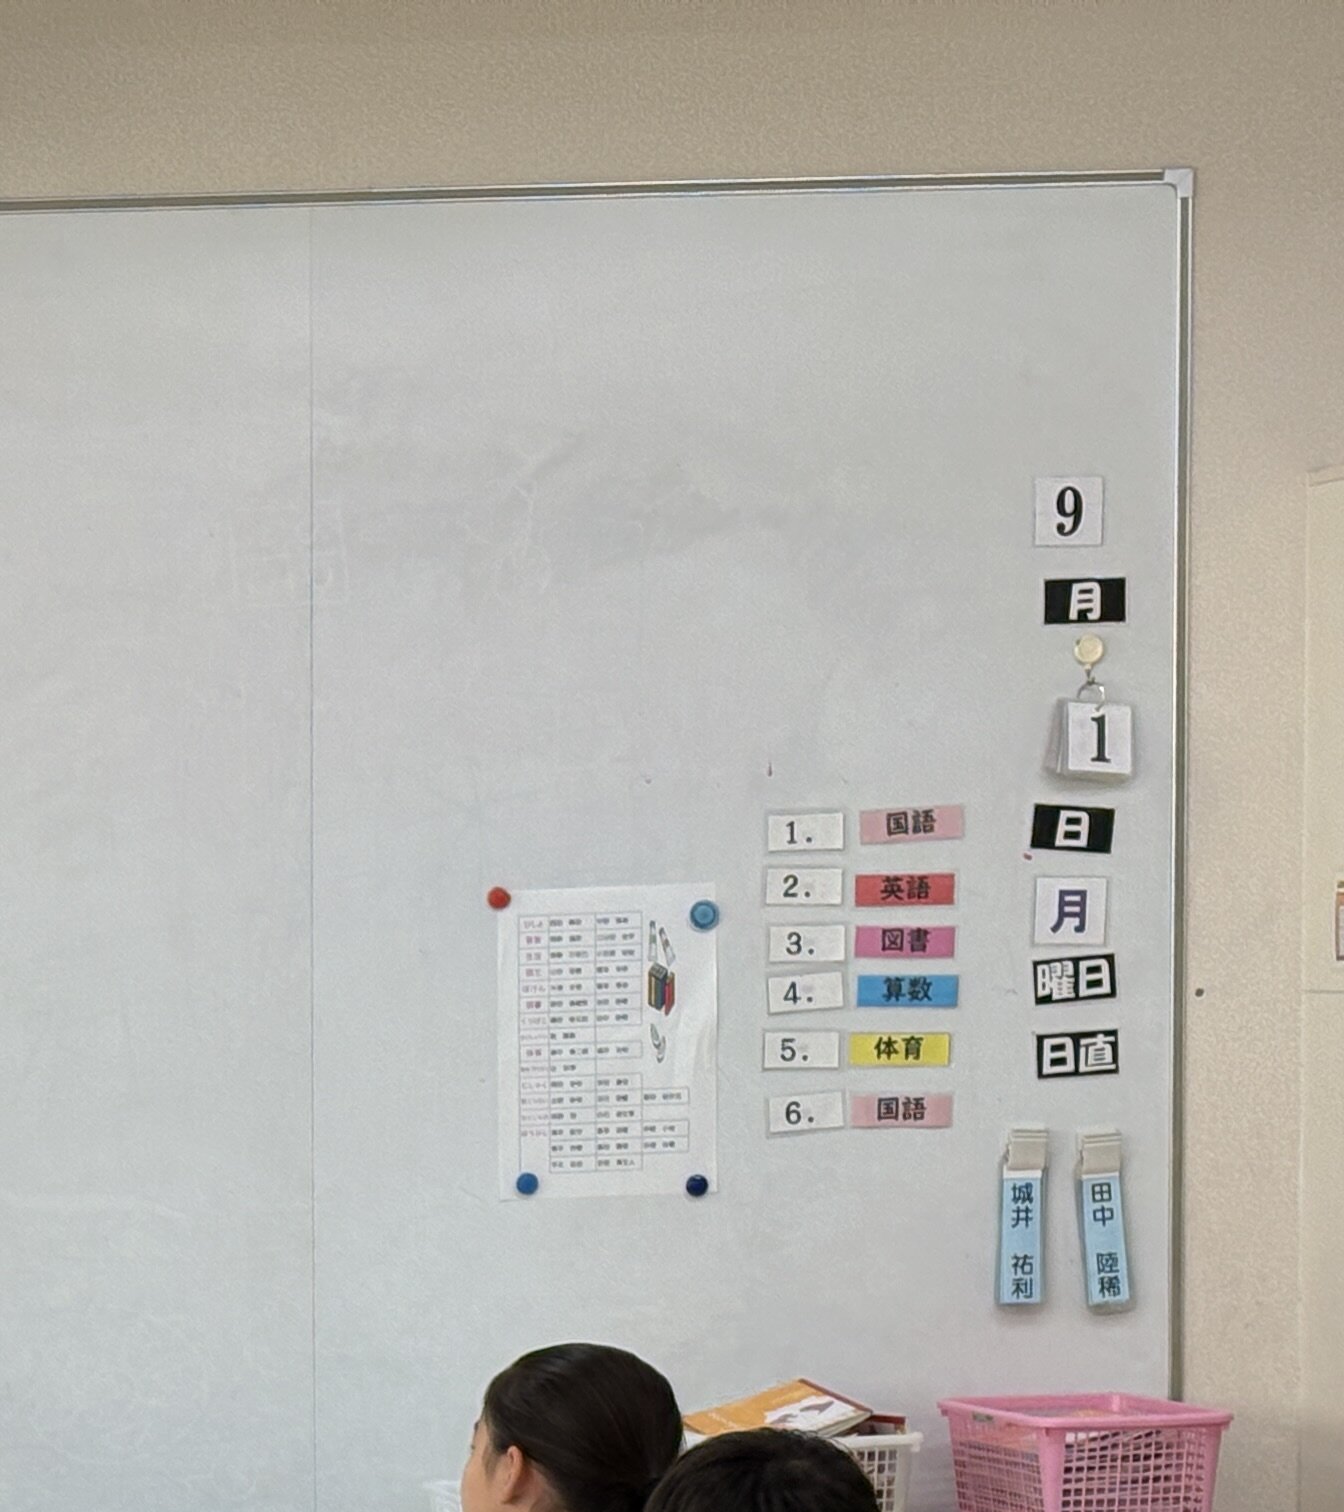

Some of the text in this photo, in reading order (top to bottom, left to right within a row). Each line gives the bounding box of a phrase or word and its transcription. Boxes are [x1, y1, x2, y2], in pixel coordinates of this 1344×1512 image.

[1055, 485, 1084, 537] 9
[1068, 581, 1102, 621] 月
[1090, 712, 1112, 763] 1
[785, 808, 937, 844] 1. 国語
[1054, 809, 1091, 848] 日
[782, 873, 931, 900] 2. 英語
[1049, 889, 1088, 934] 月
[785, 927, 930, 956] 3. 図書
[782, 976, 933, 1003] 4. 算数
[1036, 957, 1112, 1001] 曜日
[779, 1036, 924, 1062] 5. 体育
[1041, 1033, 1117, 1076] 日直
[784, 1096, 927, 1124] 6. 国語
[1010, 1181, 1034, 1229] 城井
[1091, 1182, 1115, 1228] 田中
